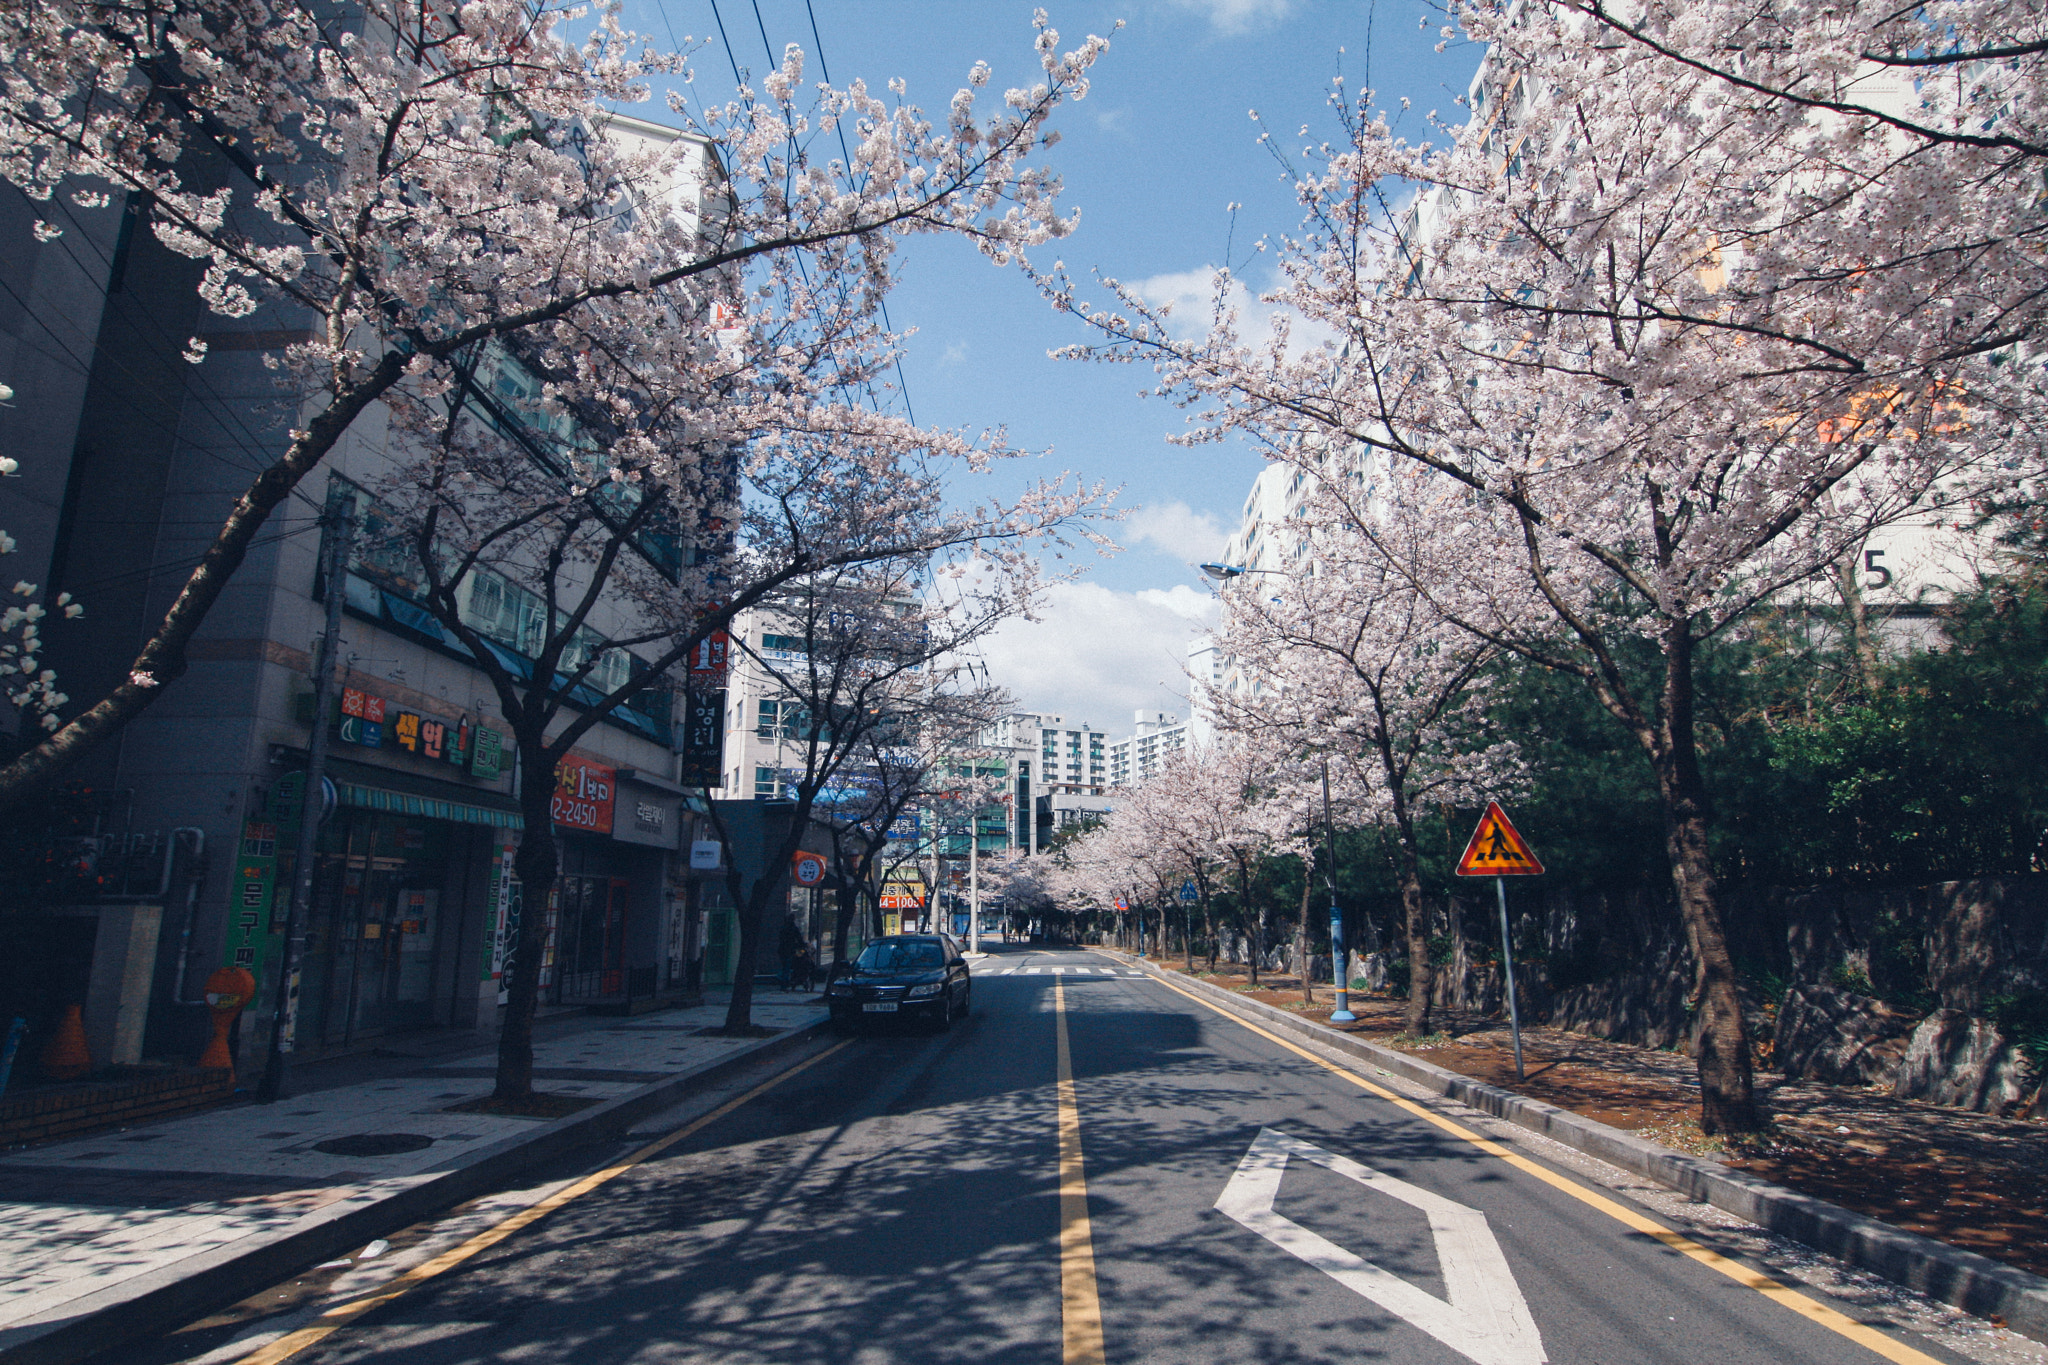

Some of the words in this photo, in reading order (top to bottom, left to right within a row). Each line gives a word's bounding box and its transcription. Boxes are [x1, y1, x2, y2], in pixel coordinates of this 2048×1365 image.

[1864, 549, 1892, 590] 5
[394, 711, 469, 766] 색연필
[478, 729, 499, 750] 문구
[476, 748, 498, 769] 팬시
